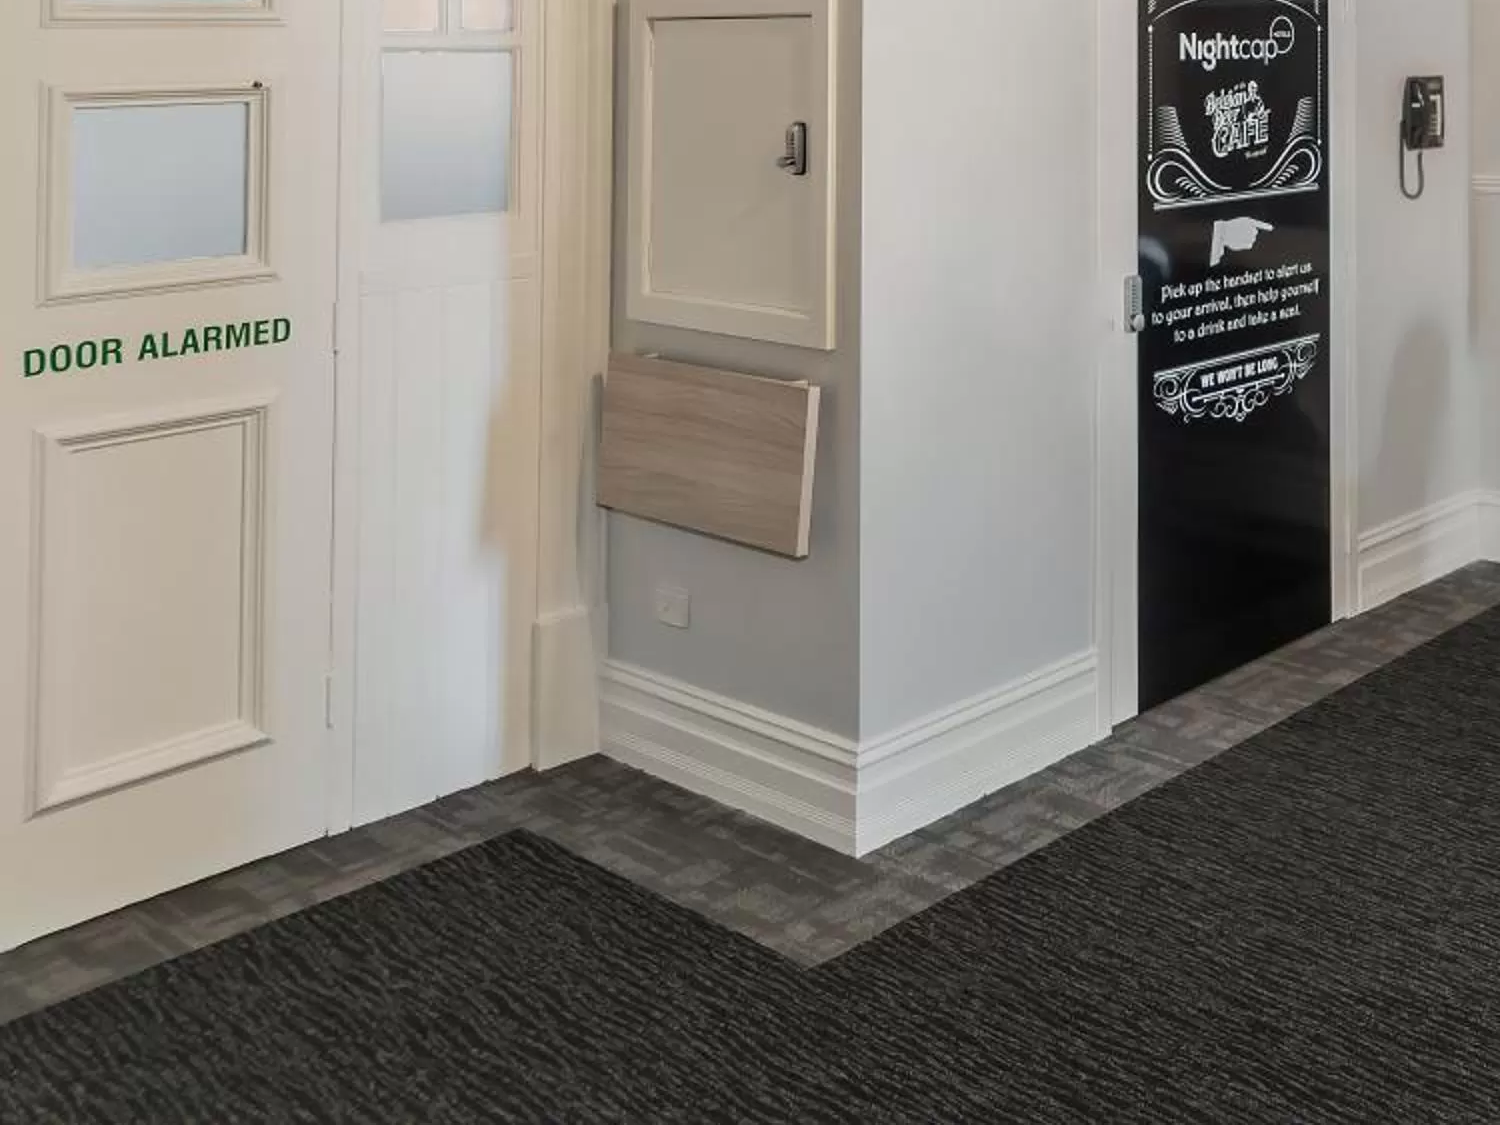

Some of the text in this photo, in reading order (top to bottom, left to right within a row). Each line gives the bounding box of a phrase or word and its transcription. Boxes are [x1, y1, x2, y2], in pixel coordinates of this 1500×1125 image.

[1179, 32, 1279, 71] Nightcap
[1151, 310, 1164, 324] to
[1166, 306, 1193, 326] your
[1234, 293, 1256, 308] then
[1257, 287, 1279, 304] help
[1280, 278, 1320, 301] yourself
[1161, 262, 1312, 303] Pick up the handset to alert us
[1173, 328, 1187, 342] to
[1188, 330, 1195, 341] a
[1197, 319, 1226, 338] drink
[1227, 315, 1247, 331] and
[1248, 312, 1269, 327] take
[1271, 311, 1277, 322] a
[23, 318, 292, 377] DOOR ALARMED
[1201, 372, 1215, 388] WE
[1244, 362, 1256, 378] BE
[1257, 356, 1279, 374] LONG
